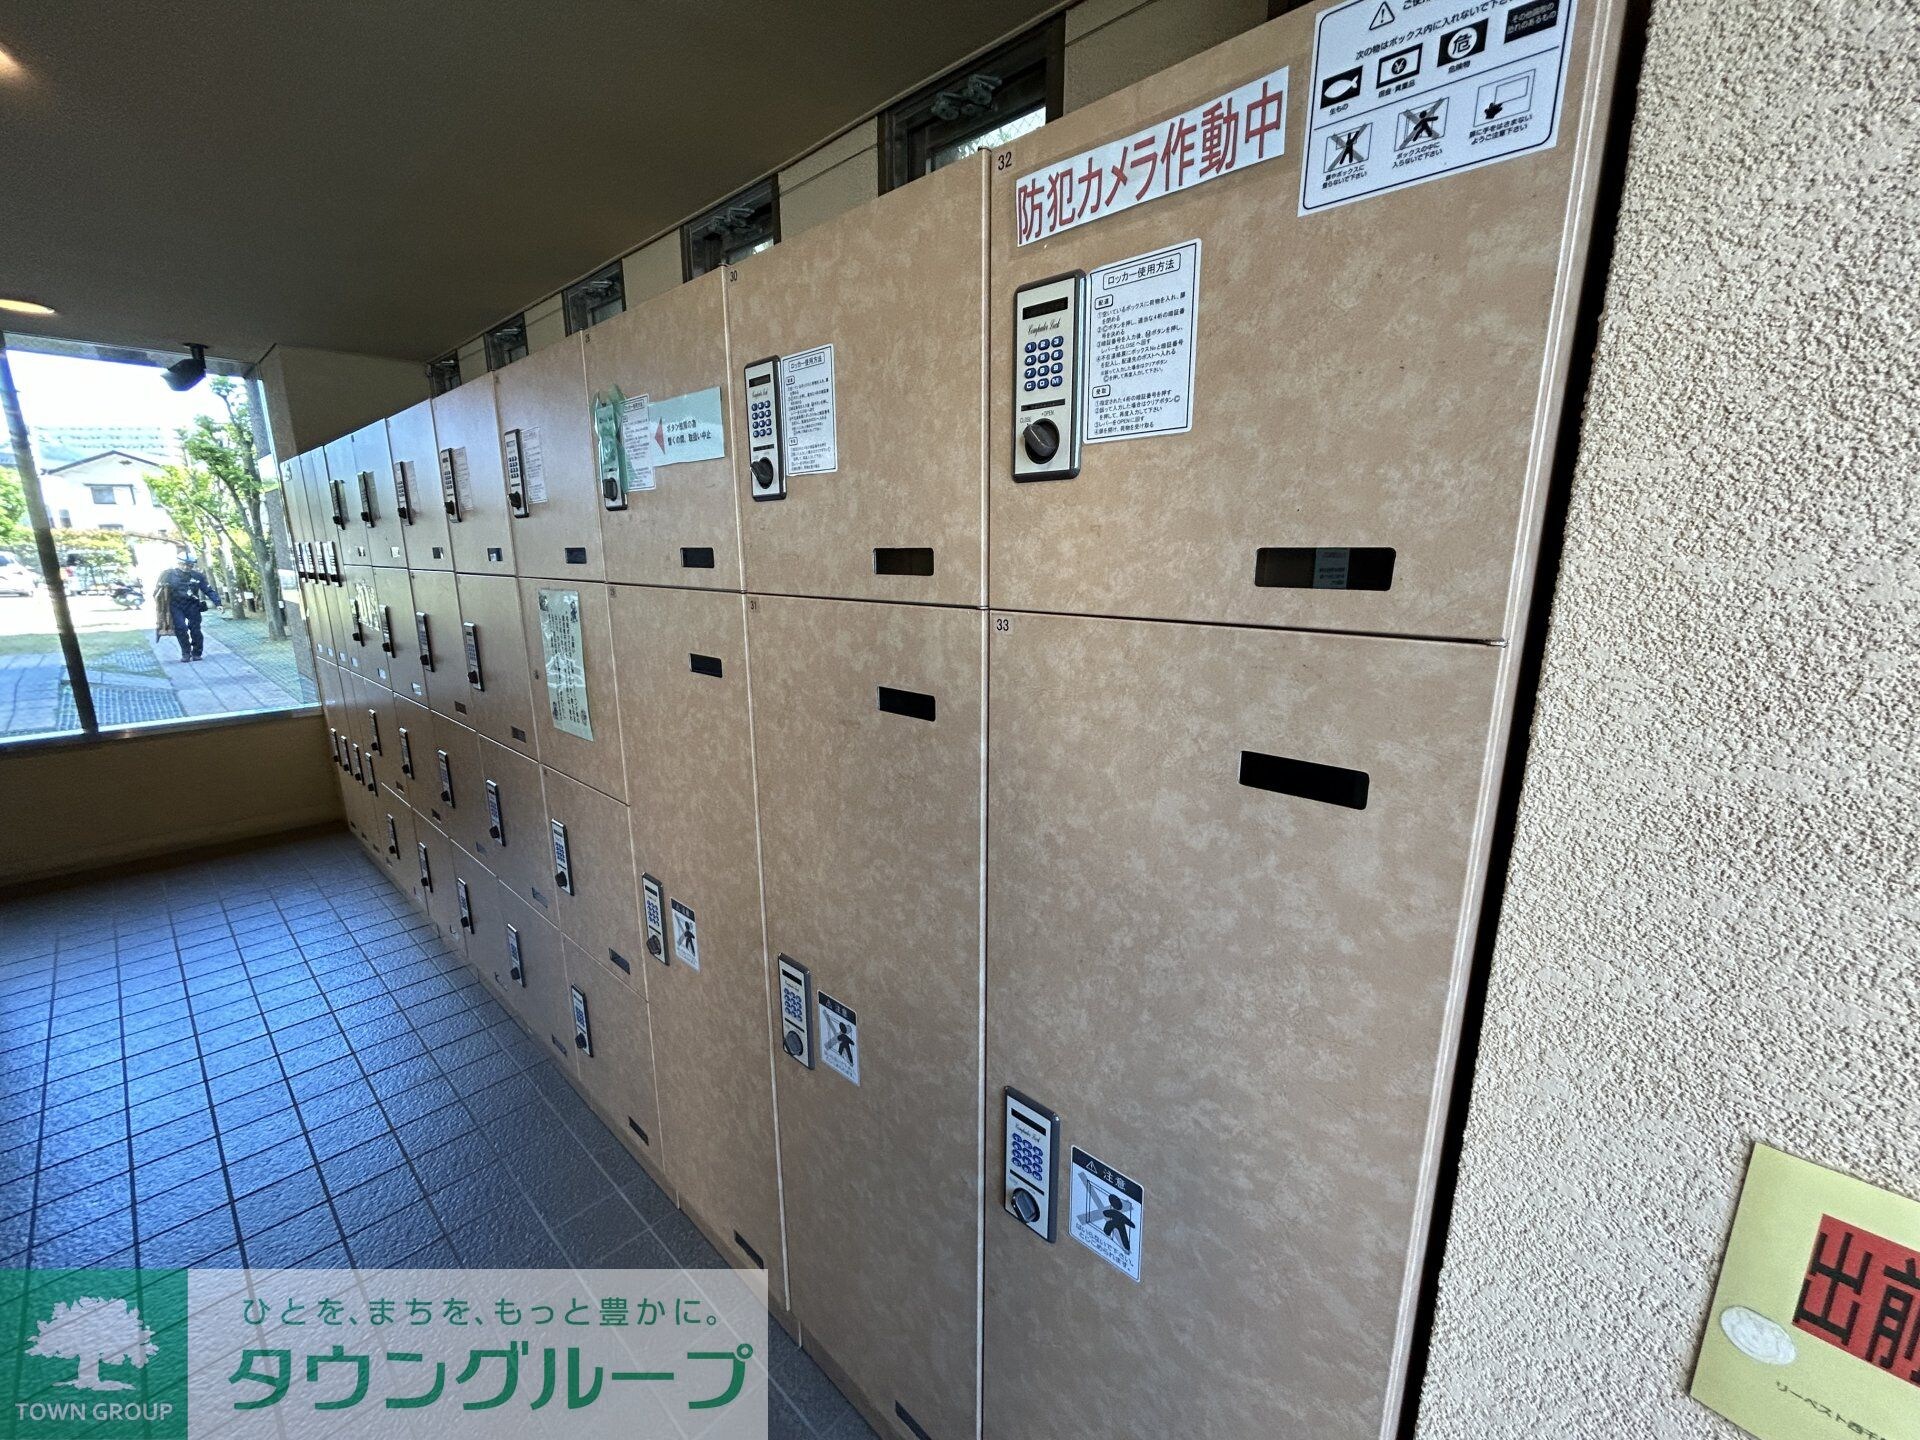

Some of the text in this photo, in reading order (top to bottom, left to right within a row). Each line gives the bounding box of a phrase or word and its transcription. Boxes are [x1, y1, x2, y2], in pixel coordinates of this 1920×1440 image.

[1452, 33, 1472, 55] 危
[997, 151, 1012, 171] 32
[1018, 80, 1284, 246] 防犯カメラ作動中
[1107, 257, 1175, 285] ロッカー使用方法
[996, 618, 1010, 632] 33
[1102, 1168, 1126, 1191] 注意
